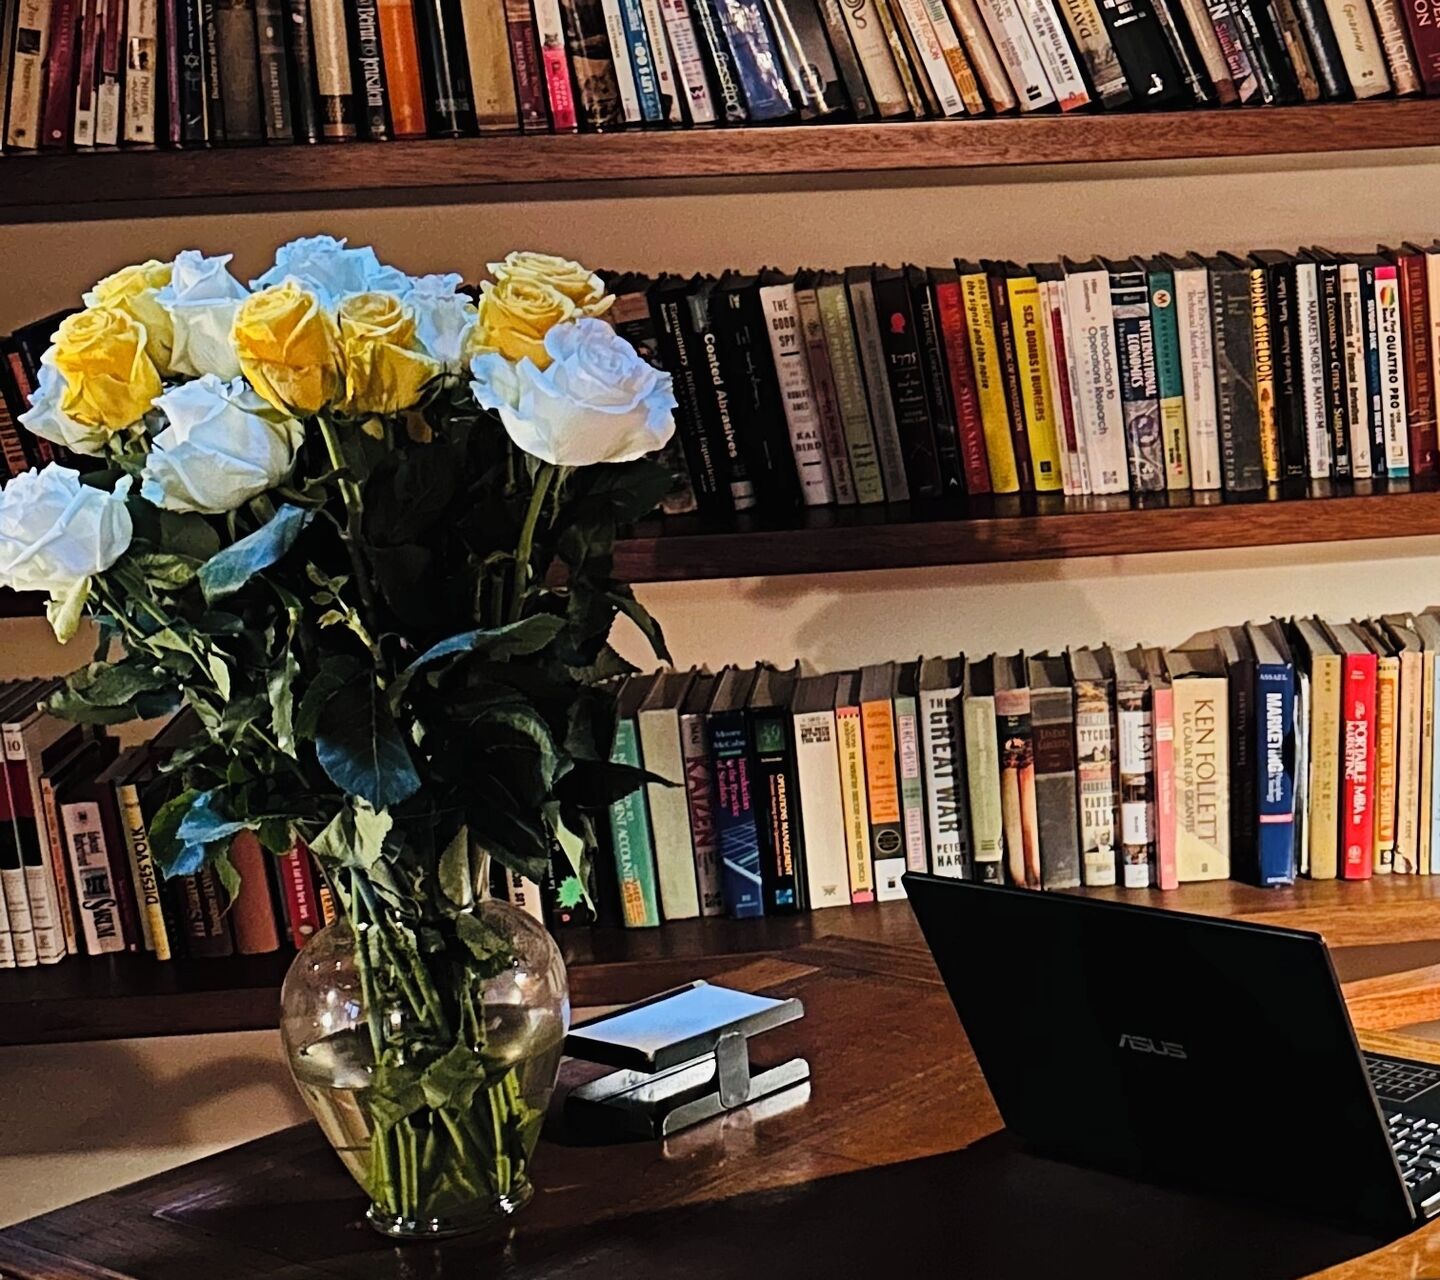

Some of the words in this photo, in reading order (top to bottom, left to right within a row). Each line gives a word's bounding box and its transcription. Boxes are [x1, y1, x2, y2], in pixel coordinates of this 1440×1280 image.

[357, 6, 378, 41] Beirut
[1041, 14, 1075, 83] SINGULARITY
[357, 54, 385, 107] Jerusalem
[965, 279, 977, 296] the
[1324, 275, 1336, 294] THE
[1409, 265, 1421, 285] THE
[1410, 287, 1422, 303] DA
[772, 299, 789, 314] THE
[966, 297, 981, 327] signal
[1249, 273, 1269, 319] SIDNEY
[772, 316, 796, 331] GOOD
[972, 326, 984, 346] and
[1325, 296, 1340, 350] ECONOMICS
[1411, 303, 1424, 334] VINCI
[778, 333, 796, 348] SPY
[975, 346, 986, 363] the
[1086, 325, 1104, 384] Operations
[1098, 324, 1115, 387] Introduction
[1125, 332, 1144, 388] ECONOMICS
[1138, 318, 1157, 397] INTERNATIONAL
[1253, 321, 1273, 383] SHELDON
[1308, 346, 1322, 375] MOBS
[1384, 334, 1399, 384] QUATTRO
[1413, 336, 1426, 363] CODE
[702, 331, 725, 386] Coated
[714, 387, 741, 459] Abrasives
[977, 363, 990, 390] noise
[1330, 360, 1343, 391] CITIES
[666, 300, 691, 368] Elementary
[697, 435, 719, 493] Equations
[959, 385, 976, 430] SYLVIA
[1029, 374, 1046, 422] BURGERS
[1093, 385, 1109, 435] Research
[1311, 385, 1326, 429] MAYHEM
[1388, 386, 1400, 409] PRO
[966, 431, 981, 470] NASAR
[1192, 698, 1215, 745] KEN
[1379, 683, 1393, 724] MUNDO
[928, 710, 959, 781] GREAT
[1352, 719, 1368, 784] PORTABLE
[1379, 726, 1393, 764] ANCHO
[1379, 764, 1392, 785] DEL
[684, 754, 717, 849] KAIZEN
[775, 773, 788, 820] OPERATIONS
[934, 783, 964, 834] WAR
[1195, 750, 1218, 846] FOLLETT
[1352, 784, 1366, 815] MBA
[1379, 786, 1392, 826] TRAVES
[130, 824, 150, 863] VOLK
[779, 821, 793, 876] MANAGEMENT
[1380, 825, 1392, 836] A
[136, 863, 159, 906] DIESES
[1118, 1034, 1188, 1059] ASUS
